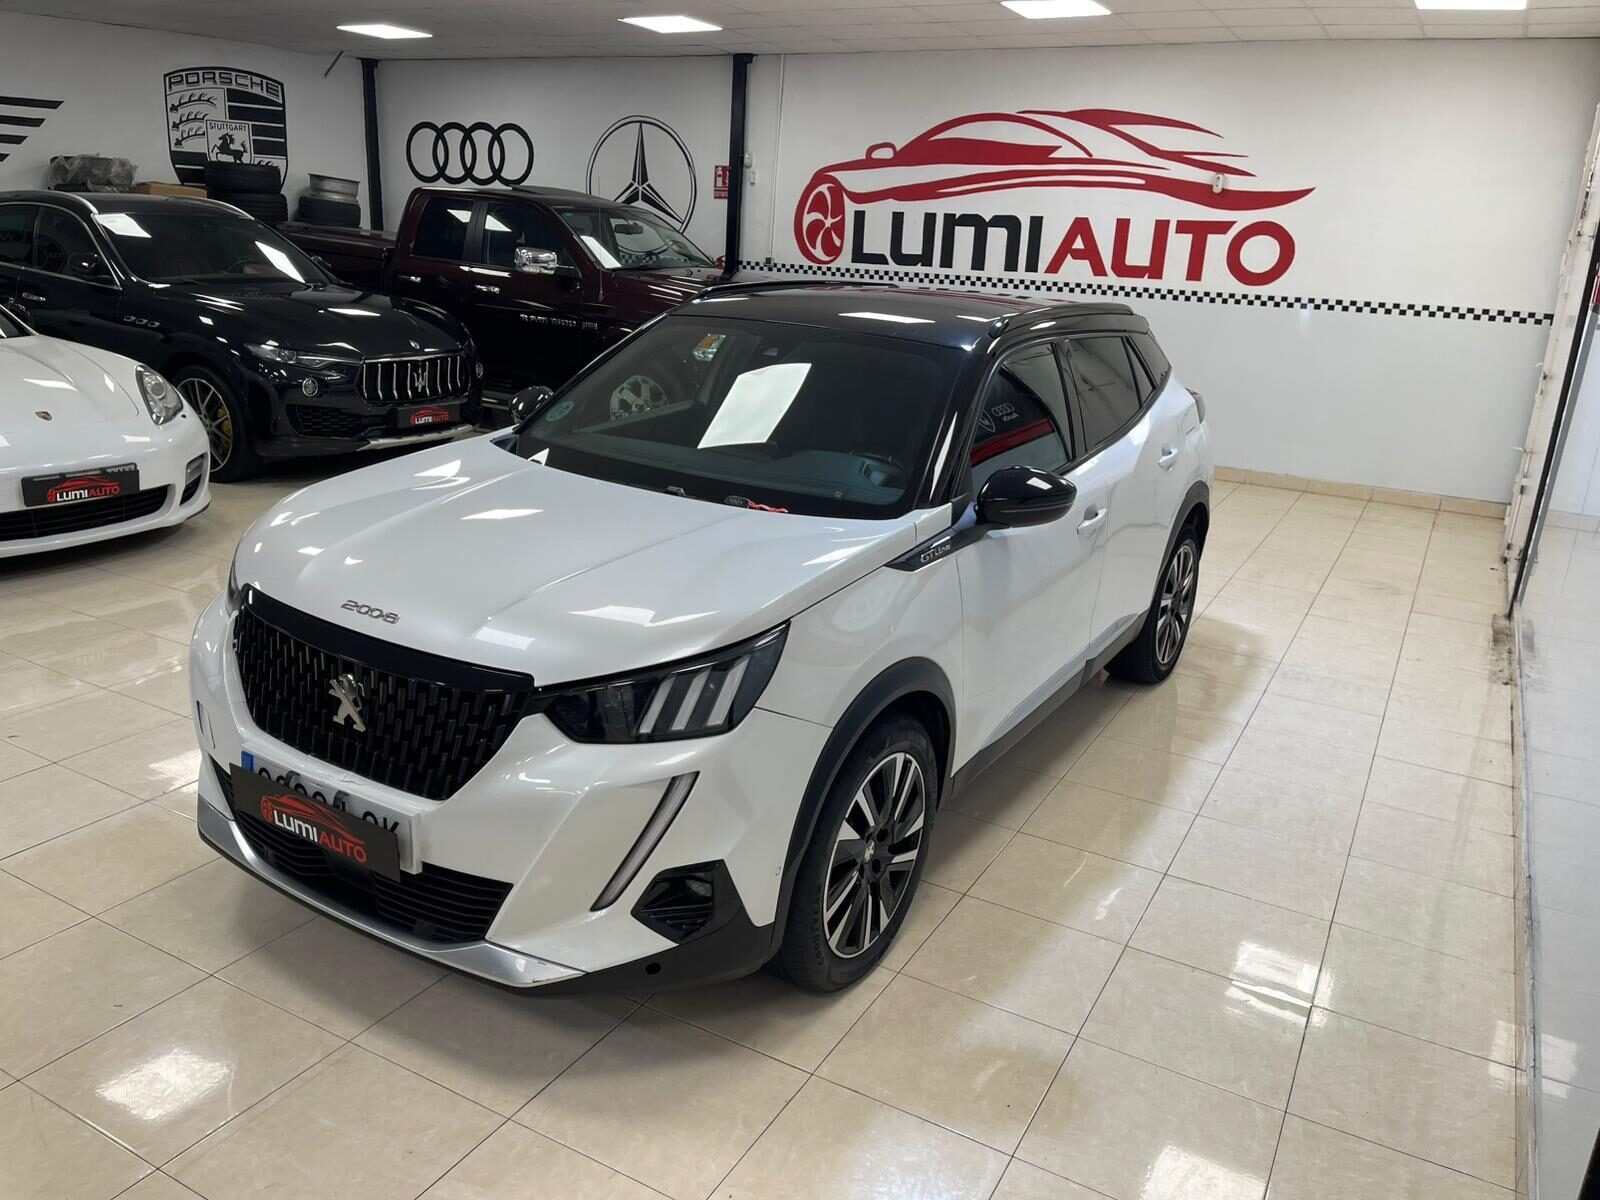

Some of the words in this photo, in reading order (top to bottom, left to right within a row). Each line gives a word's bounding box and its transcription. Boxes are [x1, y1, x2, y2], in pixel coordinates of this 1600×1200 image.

[168, 71, 280, 99] PORSCHE
[209, 122, 247, 132] STUTTGART
[340, 599, 400, 625] 2008
